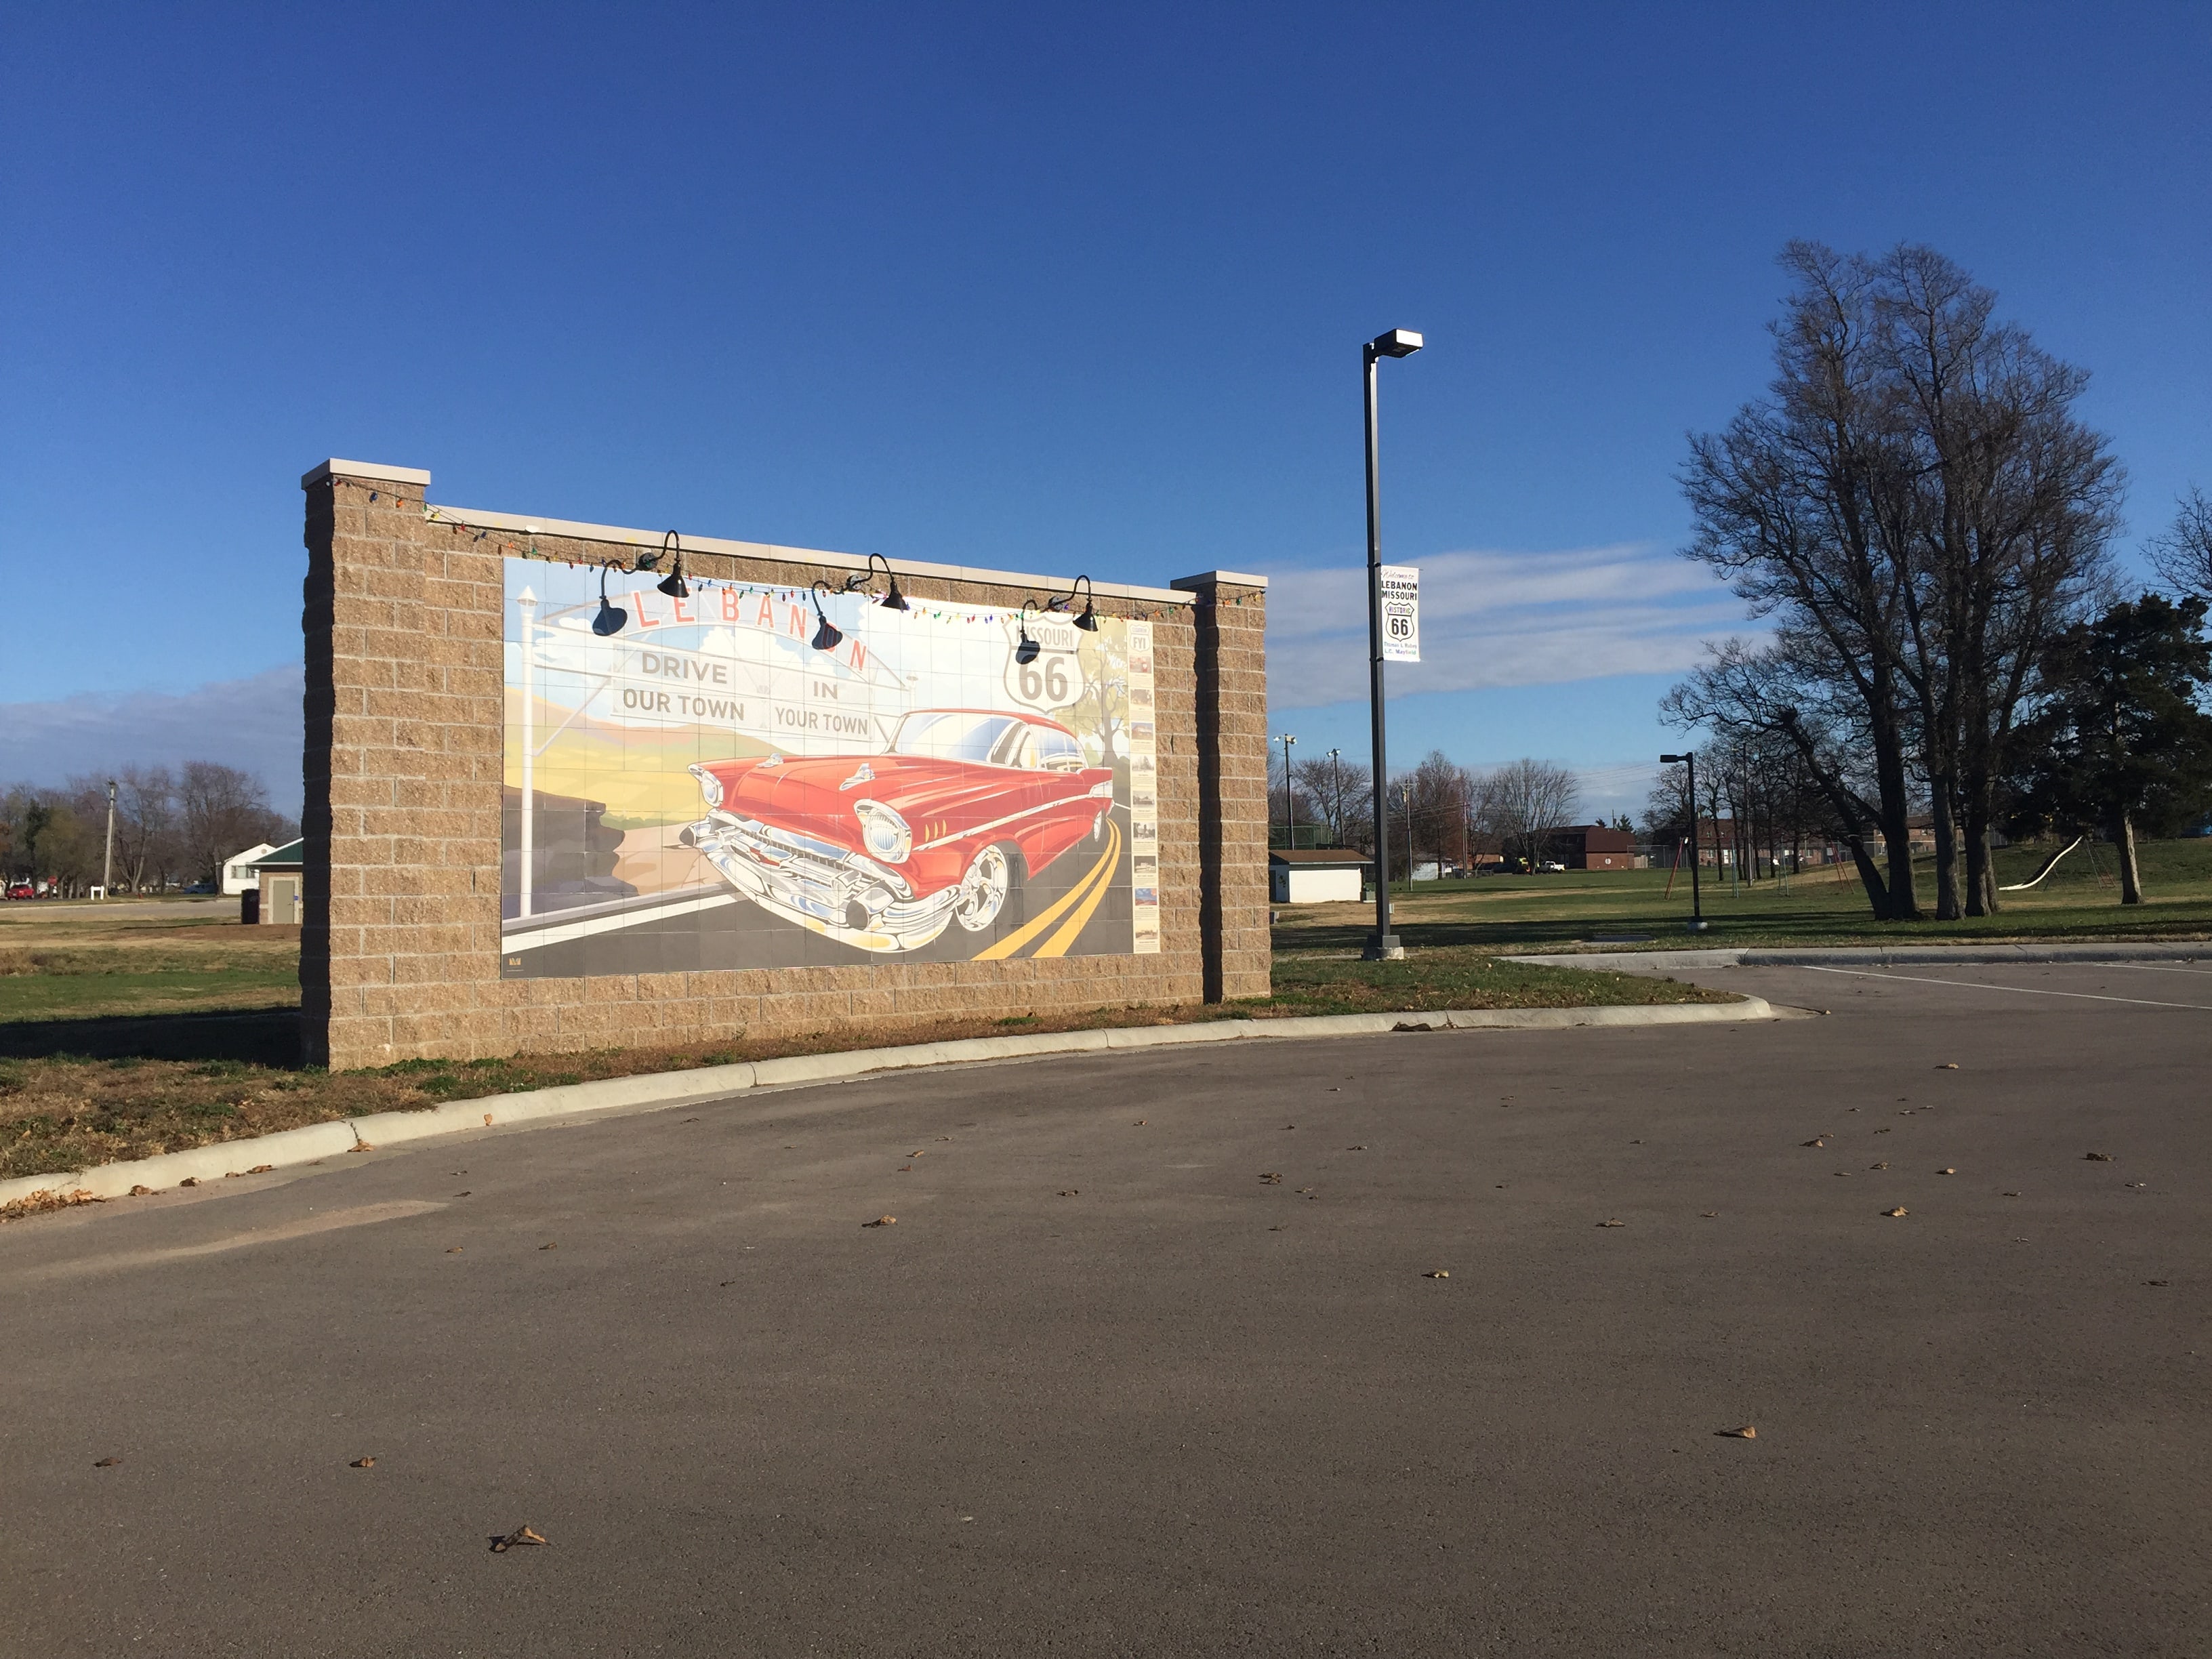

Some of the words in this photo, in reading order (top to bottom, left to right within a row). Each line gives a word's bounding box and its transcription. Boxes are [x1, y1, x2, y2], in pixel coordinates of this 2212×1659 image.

[1381, 580, 1418, 591] LEBANON
[1381, 590, 1417, 600] MISSOURI
[1389, 606, 1411, 614] HISTORIC
[633, 588, 867, 671] LEBANON
[1391, 617, 1408, 636] 66
[1133, 637, 1146, 649] FYI
[642, 652, 727, 684] DRIVE
[1019, 655, 1068, 701] 66
[813, 681, 838, 699] IN
[623, 688, 671, 713] OUR
[678, 695, 744, 721] TOWN
[775, 706, 818, 729] YOUR
[823, 713, 868, 735] TOWN
